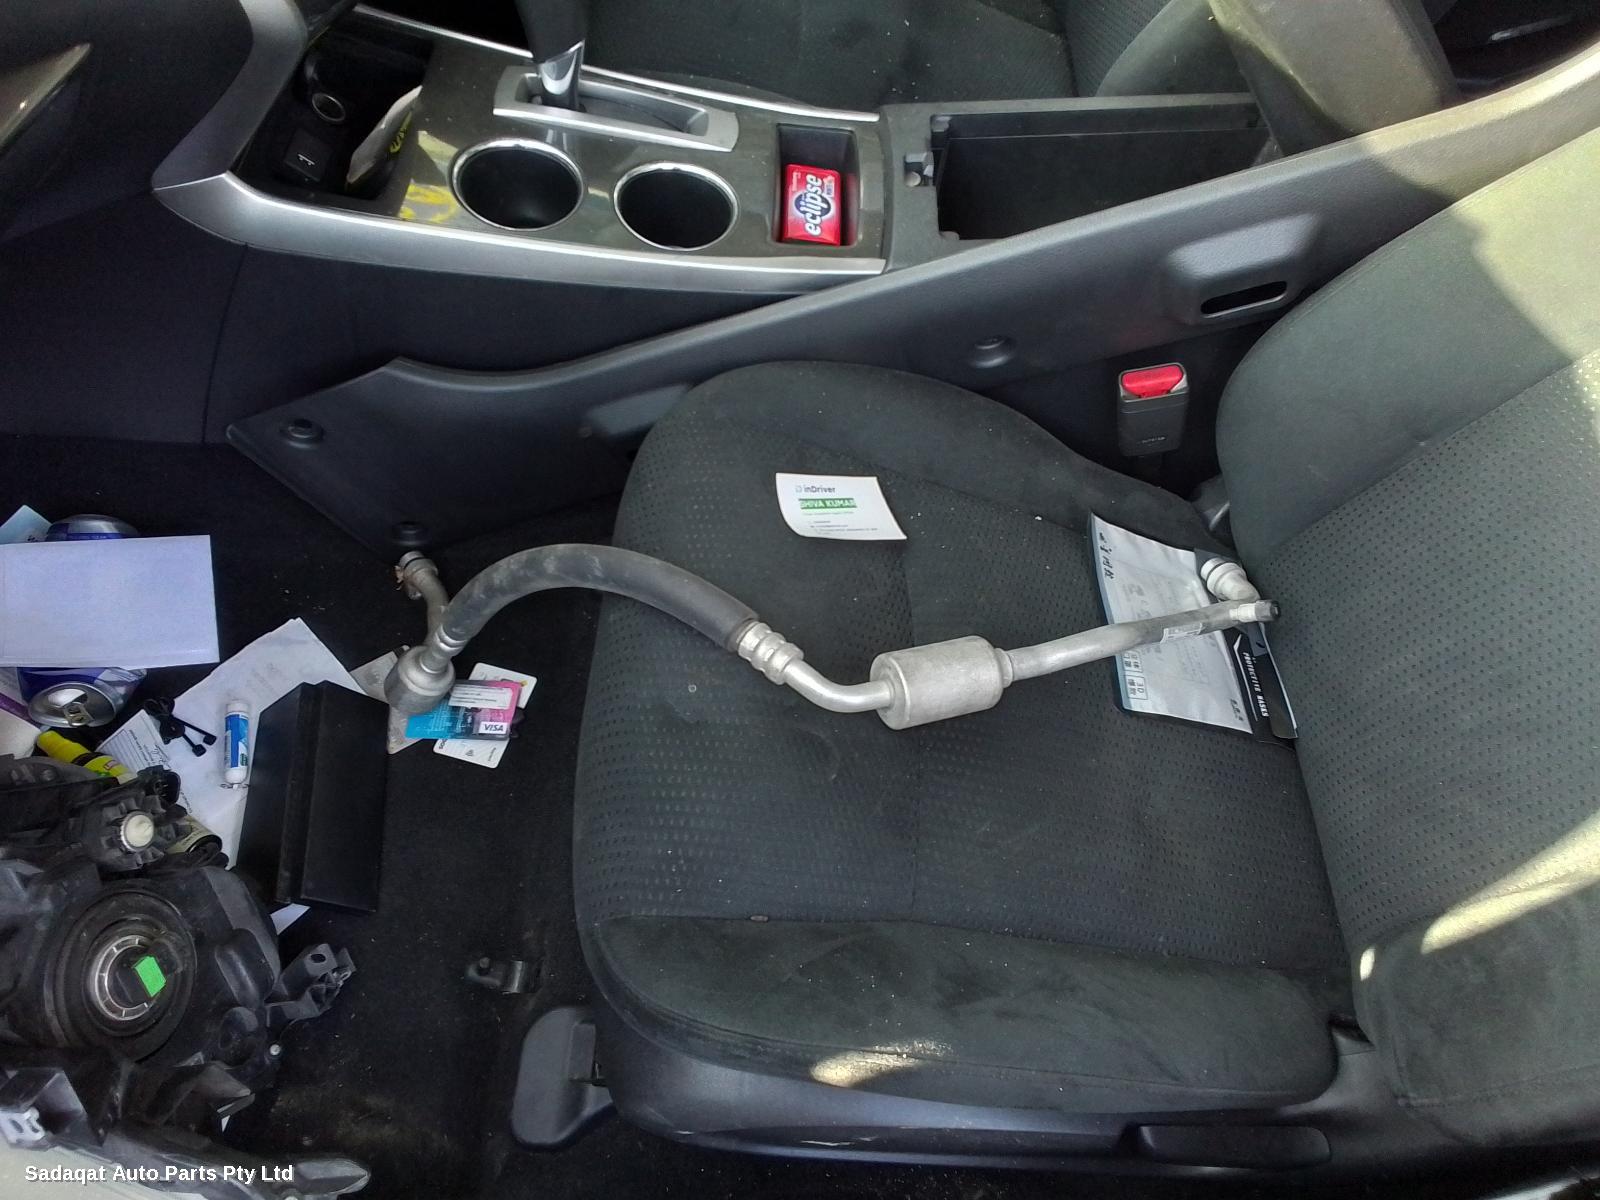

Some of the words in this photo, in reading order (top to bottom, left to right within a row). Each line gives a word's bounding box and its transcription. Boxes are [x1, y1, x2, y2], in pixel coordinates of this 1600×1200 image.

[799, 174, 828, 236] eclipse
[804, 484, 836, 493] inDriver
[1242, 651, 1262, 693] PROTECTIVE
[1256, 695, 1270, 718] MASKS
[484, 724, 504, 732] VISA
